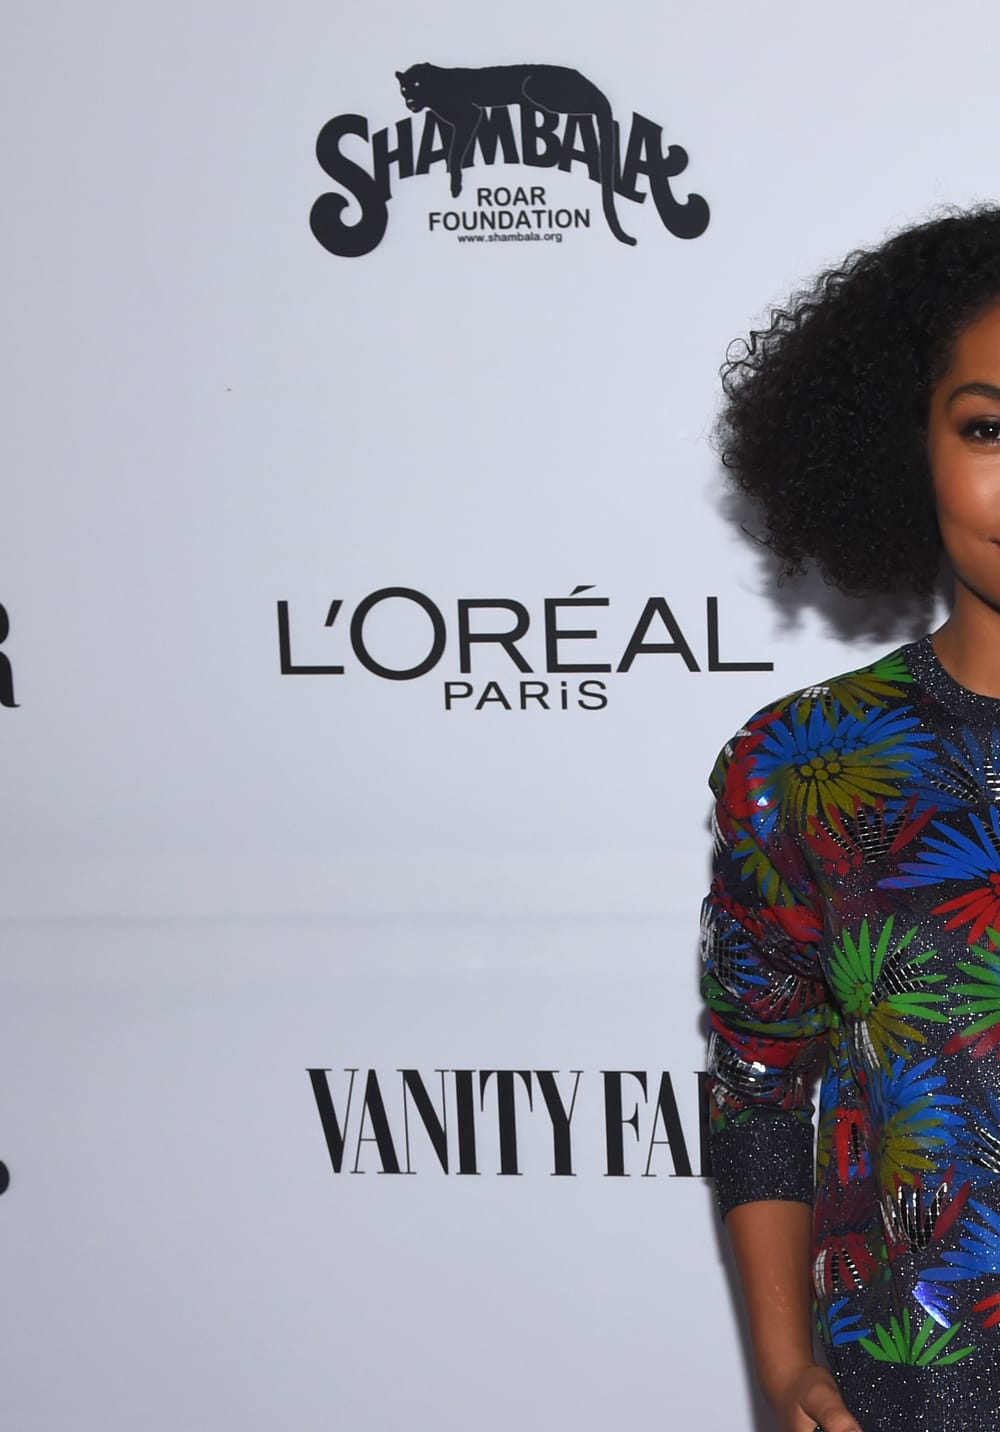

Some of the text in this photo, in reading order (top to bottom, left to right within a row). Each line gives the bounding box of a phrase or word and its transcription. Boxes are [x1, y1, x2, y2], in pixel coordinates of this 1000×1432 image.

[309, 103, 710, 257] SHAMBALA
[477, 186, 546, 207] ROAR
[429, 209, 591, 231] FOUNDATION
[457, 232, 563, 243] www.shambala.org
[277, 584, 774, 681] L'ORÉAL
[305, 1069, 584, 1176] VANITY
